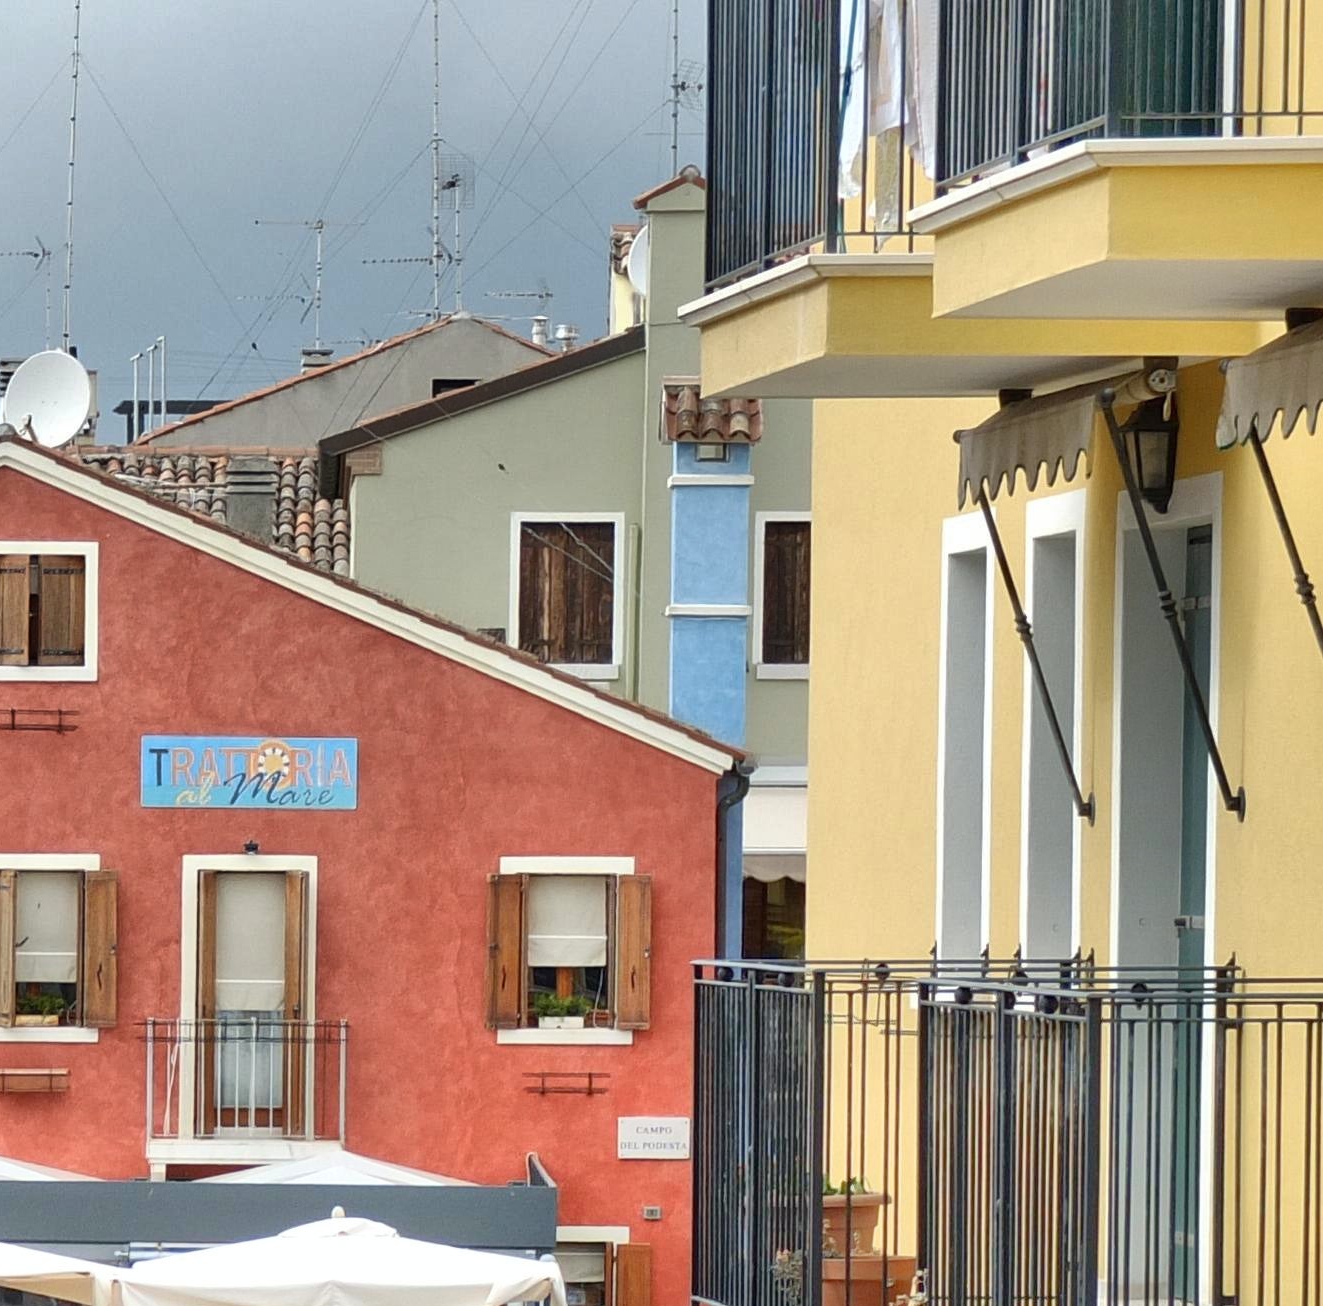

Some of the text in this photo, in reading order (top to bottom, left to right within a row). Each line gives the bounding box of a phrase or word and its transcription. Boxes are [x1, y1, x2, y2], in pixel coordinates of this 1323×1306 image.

[149, 741, 351, 788] TRATTORIA
[223, 770, 334, 805] Mare
[636, 1126, 672, 1134] CAMPO
[620, 1141, 640, 1150] DEL
